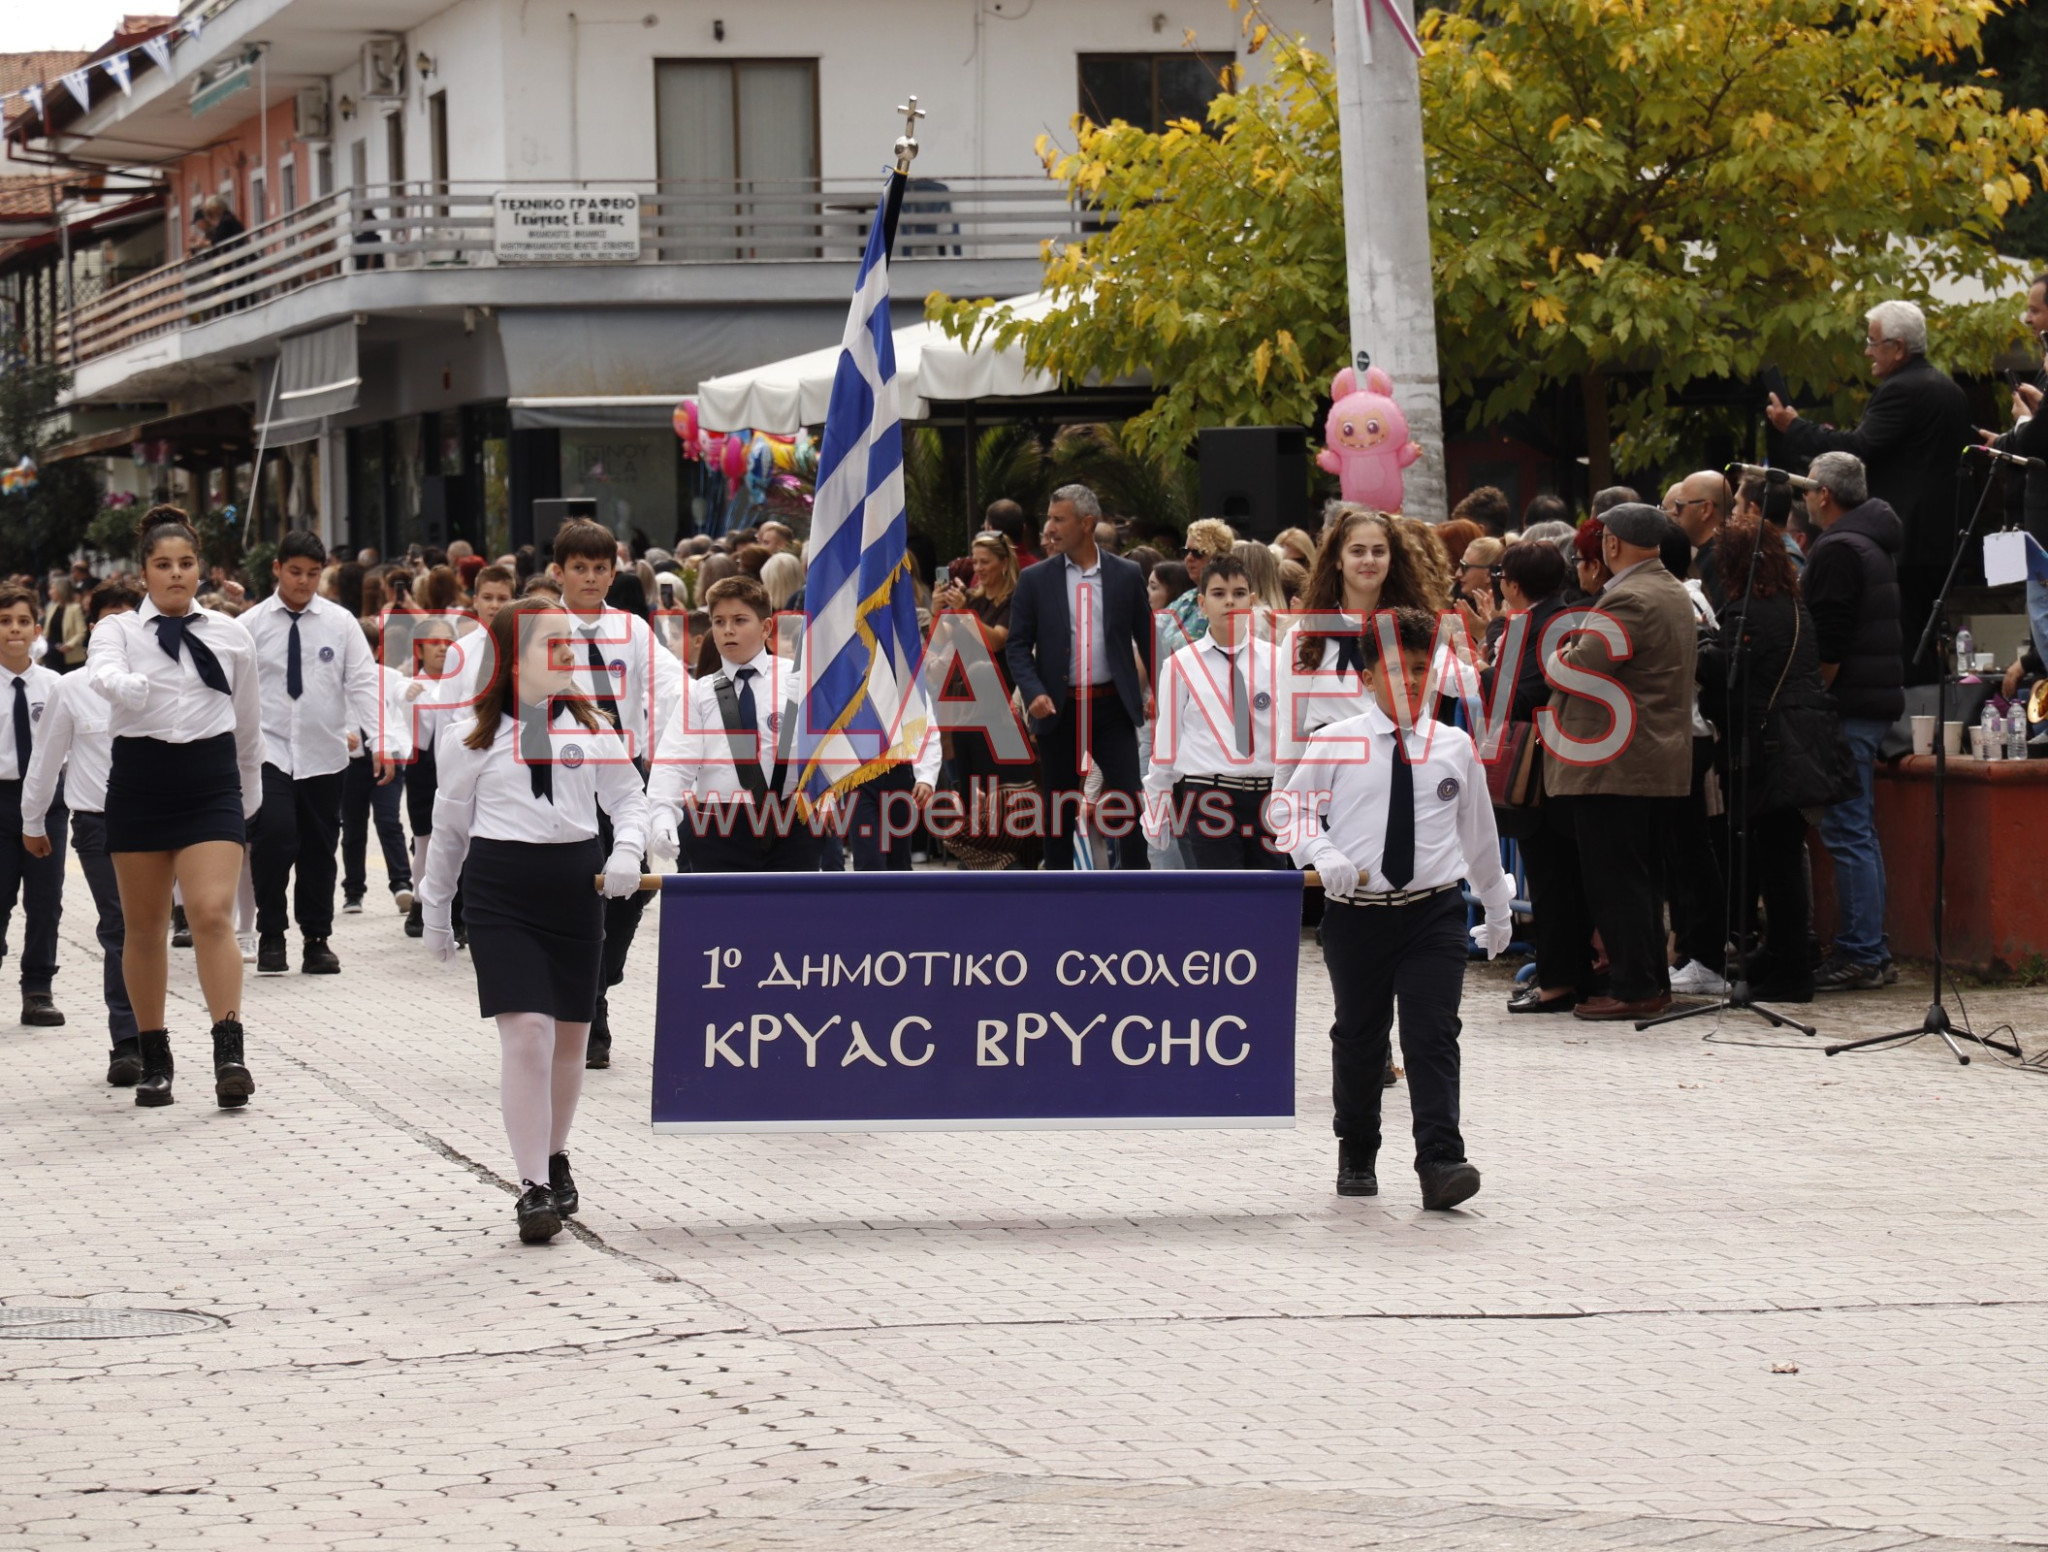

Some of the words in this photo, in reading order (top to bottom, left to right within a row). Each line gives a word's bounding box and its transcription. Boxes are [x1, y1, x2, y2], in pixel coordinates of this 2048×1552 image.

[501, 198, 565, 210] ΤΕΧΝΙΚΟ
[570, 198, 636, 210] ΓΡΑΦΕΙΟ
[757, 949, 1029, 990] ΔΗΜΟΤΙΚΟ
